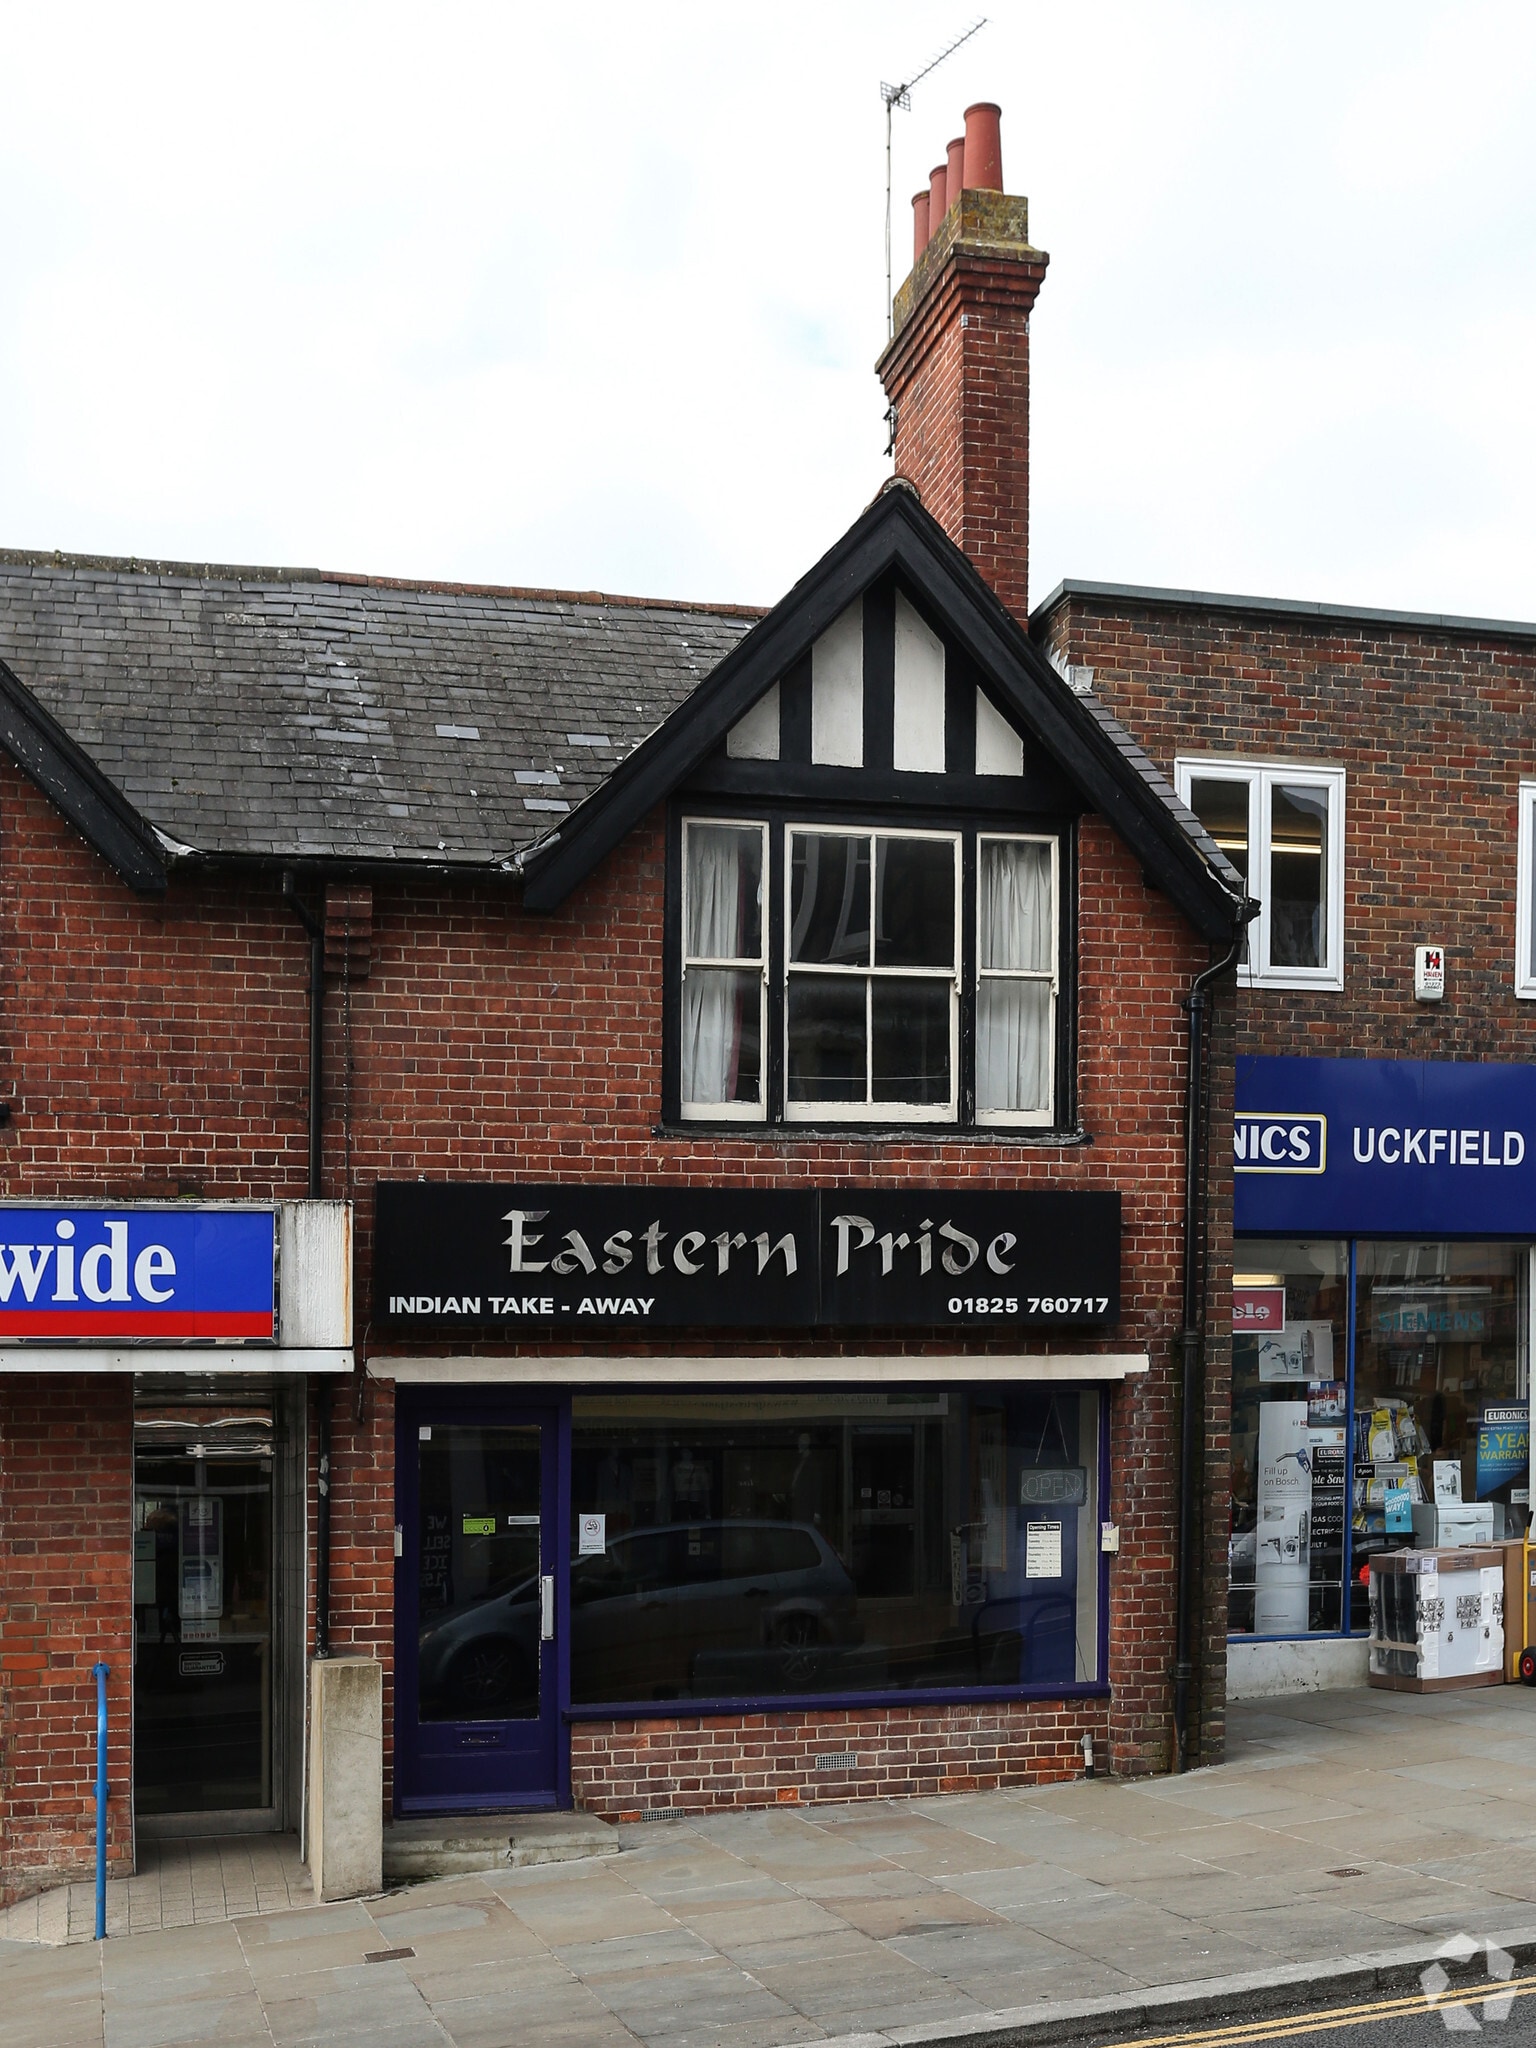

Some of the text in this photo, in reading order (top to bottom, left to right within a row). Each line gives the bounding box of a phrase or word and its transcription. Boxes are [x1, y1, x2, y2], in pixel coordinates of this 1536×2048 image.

[1353, 1126, 1526, 1166] UCKFIELD
[501, 1209, 1017, 1277] Eastern Pride
[0, 1219, 177, 1303] wide
[389, 1296, 481, 1314] INDIAN
[488, 1297, 554, 1314] TAKE
[577, 1298, 655, 1315] AWAY
[948, 1297, 1109, 1313] 01825 760717
[1378, 1311, 1484, 1332] SIEMENS
[1480, 1434, 1489, 1449] 5
[1264, 1467, 1288, 1476] Fill up
[1025, 1477, 1080, 1498] OPEN
